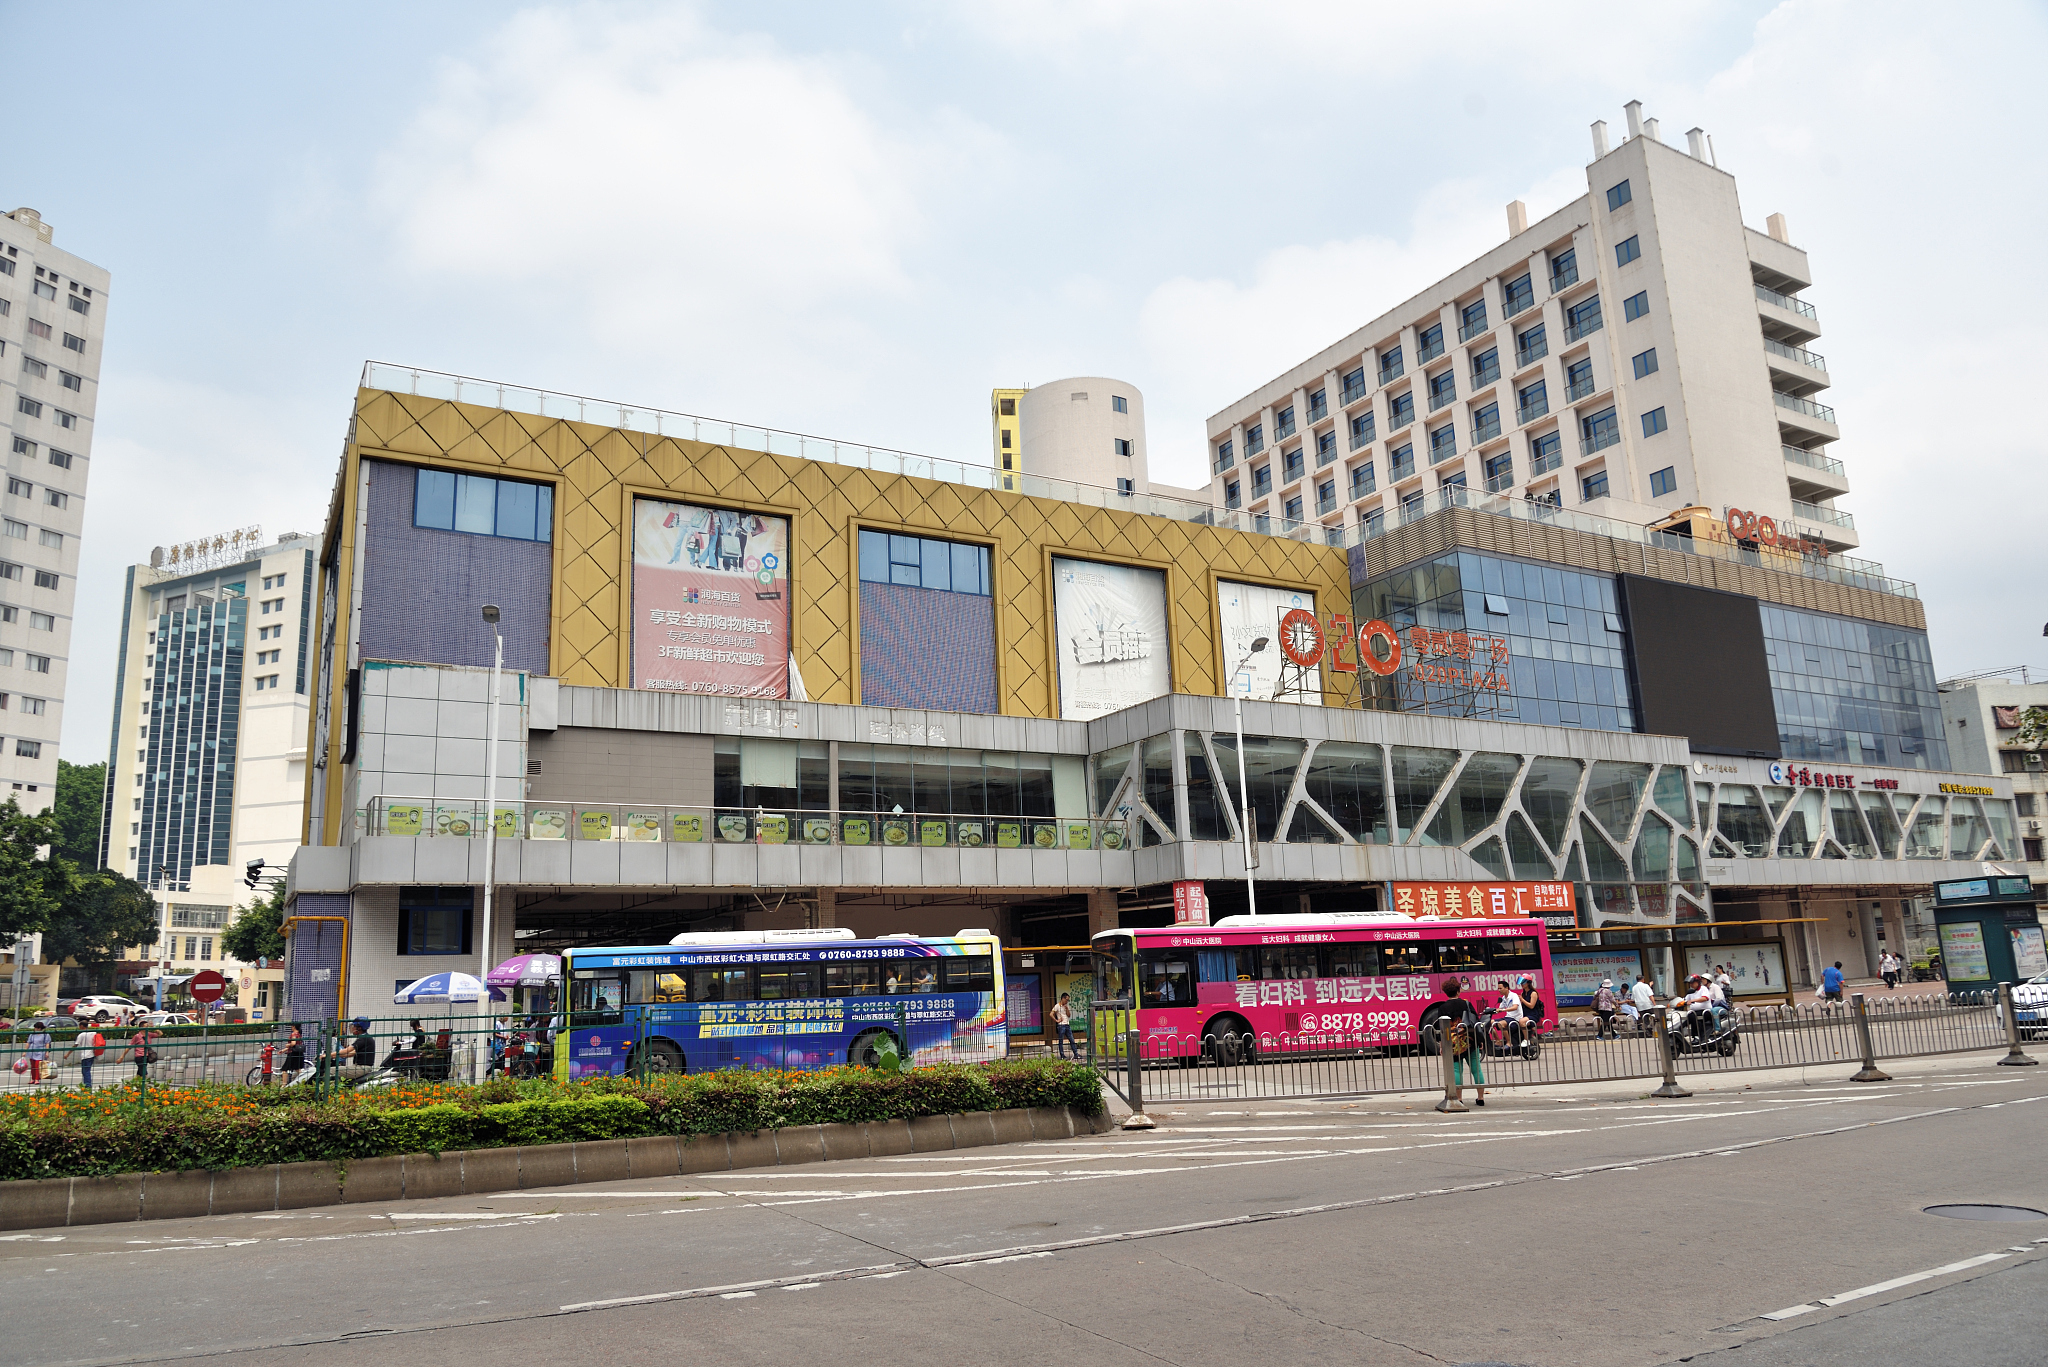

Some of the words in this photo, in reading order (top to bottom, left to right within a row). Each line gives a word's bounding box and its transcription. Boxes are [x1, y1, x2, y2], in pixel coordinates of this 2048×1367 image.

[701, 588, 741, 603] 润海百货
[649, 609, 772, 635] 享受全新购物模式
[667, 630, 756, 649] 专享会员免单优惠
[1410, 627, 1509, 664] 零贰零广场
[658, 645, 765, 666] 3F新鲜超市欢迎您
[1533, 884, 1562, 896] 自助餐厅
[1397, 885, 1530, 917] 圣琼美食百汇
[1534, 896, 1564, 908] 请上二楼
[1262, 935, 1290, 943] 远大妇科
[1294, 933, 1336, 943] 成就健康女人
[1384, 931, 1420, 940] 中山远大医院
[1456, 929, 1482, 937] 远大妇科
[1486, 928, 1524, 936] 成就健康女人
[1183, 937, 1222, 945] 中山远大医院
[612, 956, 671, 966] 富元彩虹装饰城
[679, 952, 811, 964] 中山市西区彩虹大道与翠虹路交汇处
[828, 950, 879, 960] 0760-8793
[881, 949, 905, 958] 9888
[1234, 981, 1307, 1008] 看妇科
[1316, 976, 1431, 1005] 到远大医院
[927, 999, 955, 1010] 9888
[852, 1010, 956, 1021] 中山市西区彩虹道与翠虹路交汇处
[1321, 1013, 1364, 1030] 8878
[1367, 1011, 1409, 1028] 9999
